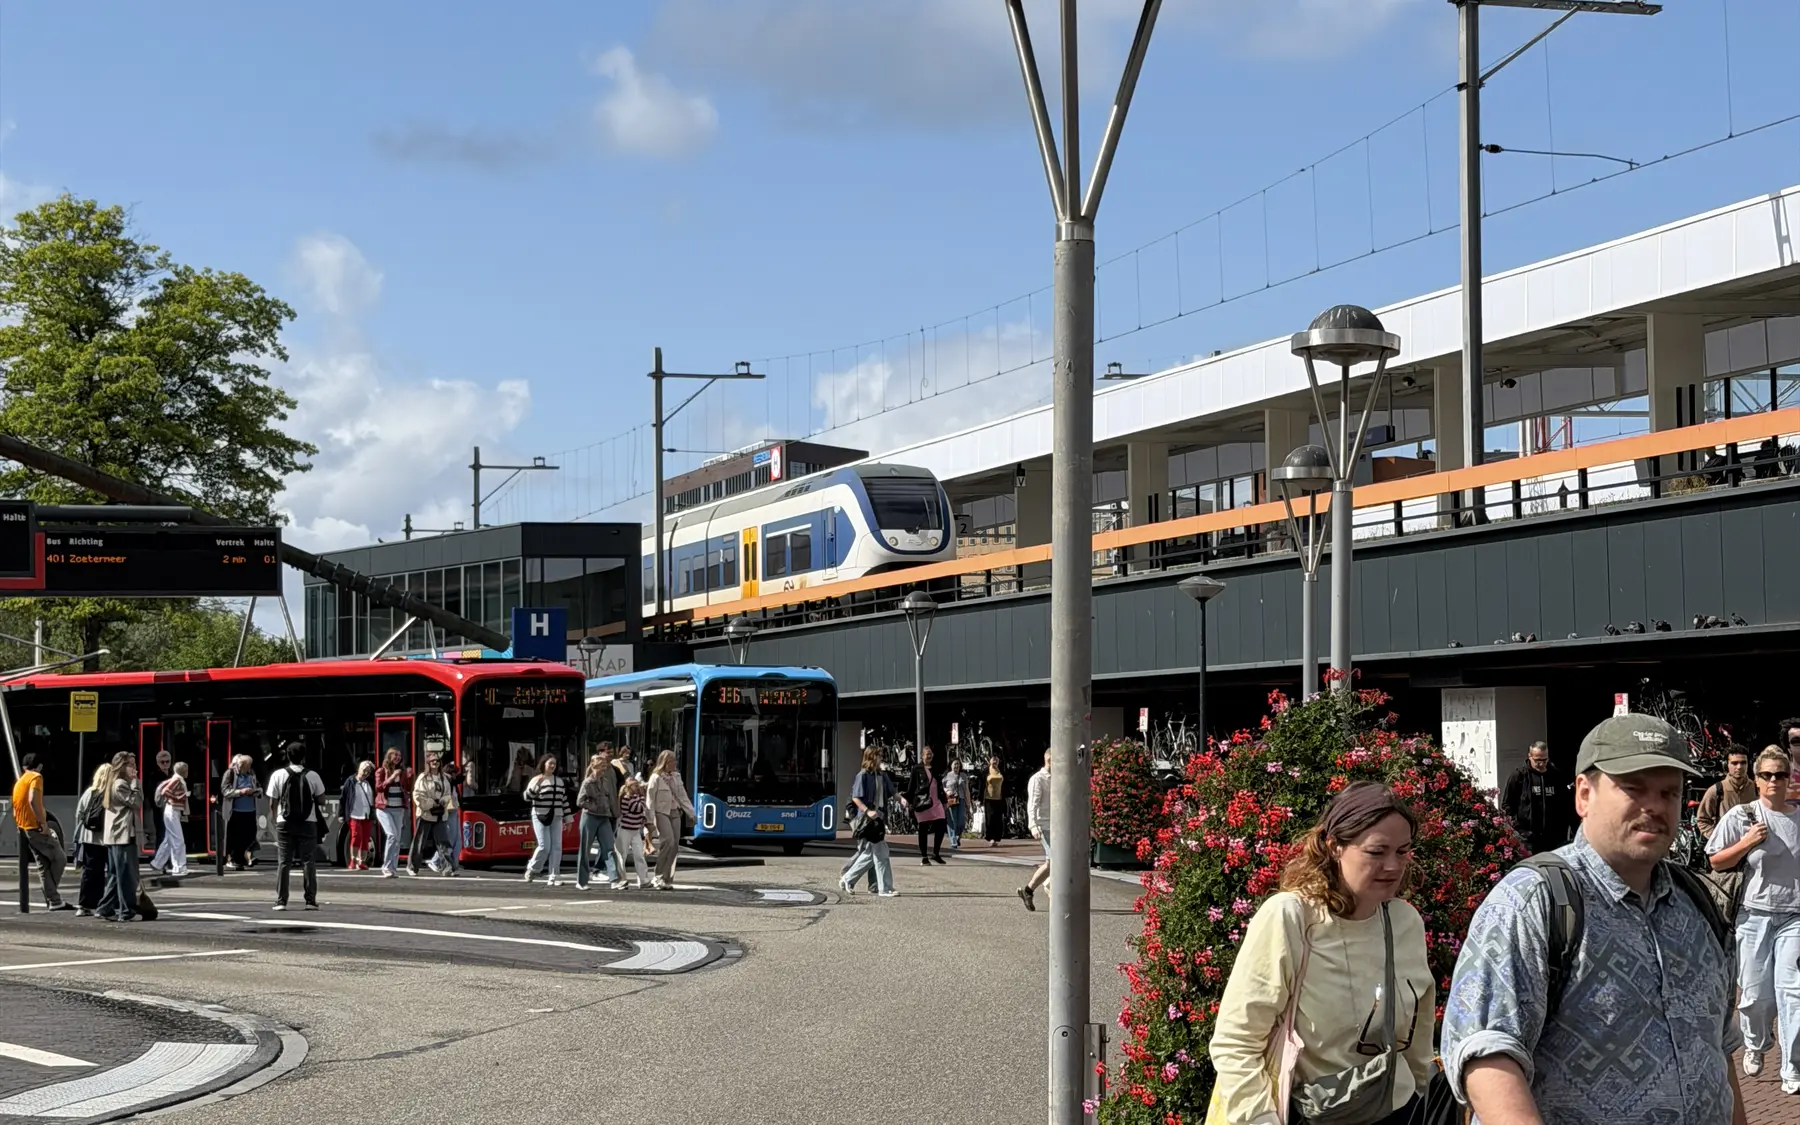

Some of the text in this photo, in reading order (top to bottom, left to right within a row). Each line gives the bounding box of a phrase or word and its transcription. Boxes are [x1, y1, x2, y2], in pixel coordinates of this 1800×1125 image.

[3, 513, 26, 522] Halte
[960, 523, 968, 534] 2
[46, 537, 275, 547] Bus Richting Vertrek Halte
[46, 554, 65, 563] 401
[69, 554, 127, 563] Zoetermeer
[222, 555, 230, 564] 2
[232, 555, 247, 564] min
[530, 613, 549, 637] H
[560, 658, 627, 672] ET KAP
[726, 795, 746, 804] 8610
[725, 809, 752, 819] Qbuzz
